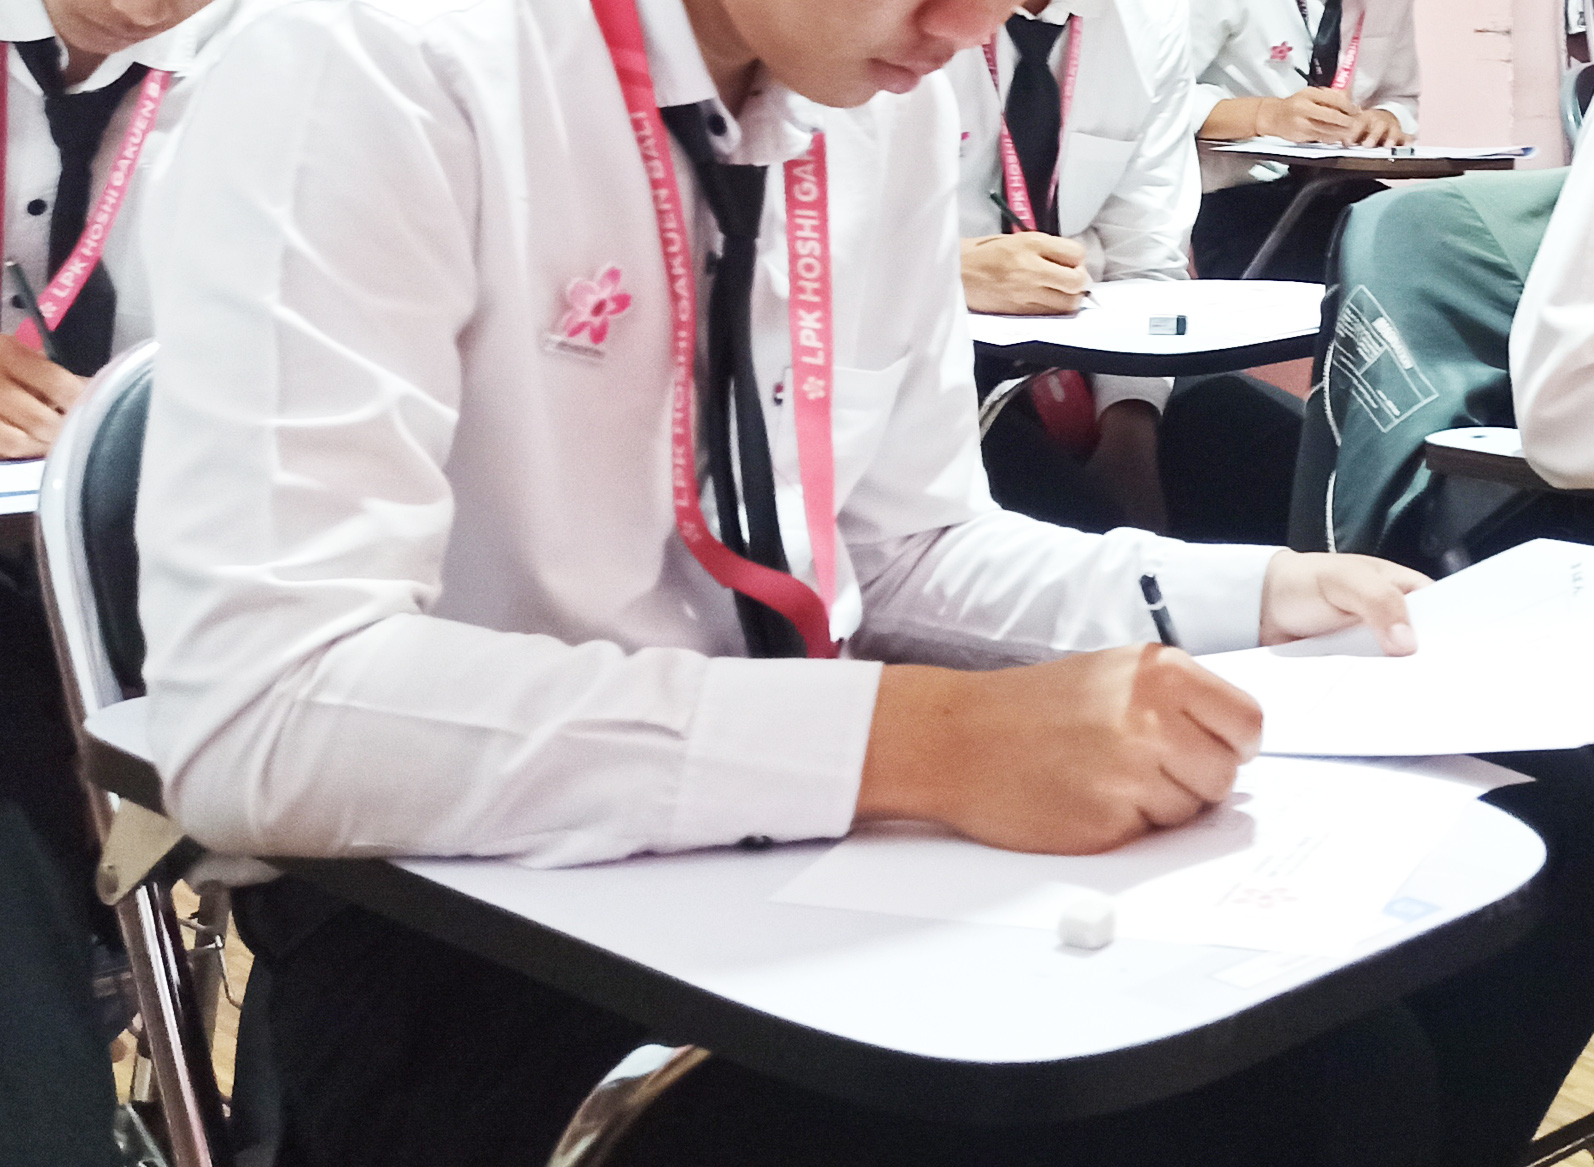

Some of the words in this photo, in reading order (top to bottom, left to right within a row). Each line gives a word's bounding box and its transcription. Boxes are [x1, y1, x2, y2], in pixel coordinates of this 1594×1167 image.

[630, 111, 666, 179] BALI
[51, 258, 90, 298] LPK
[80, 189, 120, 257] HOSHI
[112, 98, 157, 187] GAKUEN
[1011, 189, 1031, 220] LPK
[655, 187, 692, 321] GAKUEN
[793, 209, 822, 303] HOSHI
[798, 308, 825, 366] LPK
[670, 444, 690, 507] LPK
